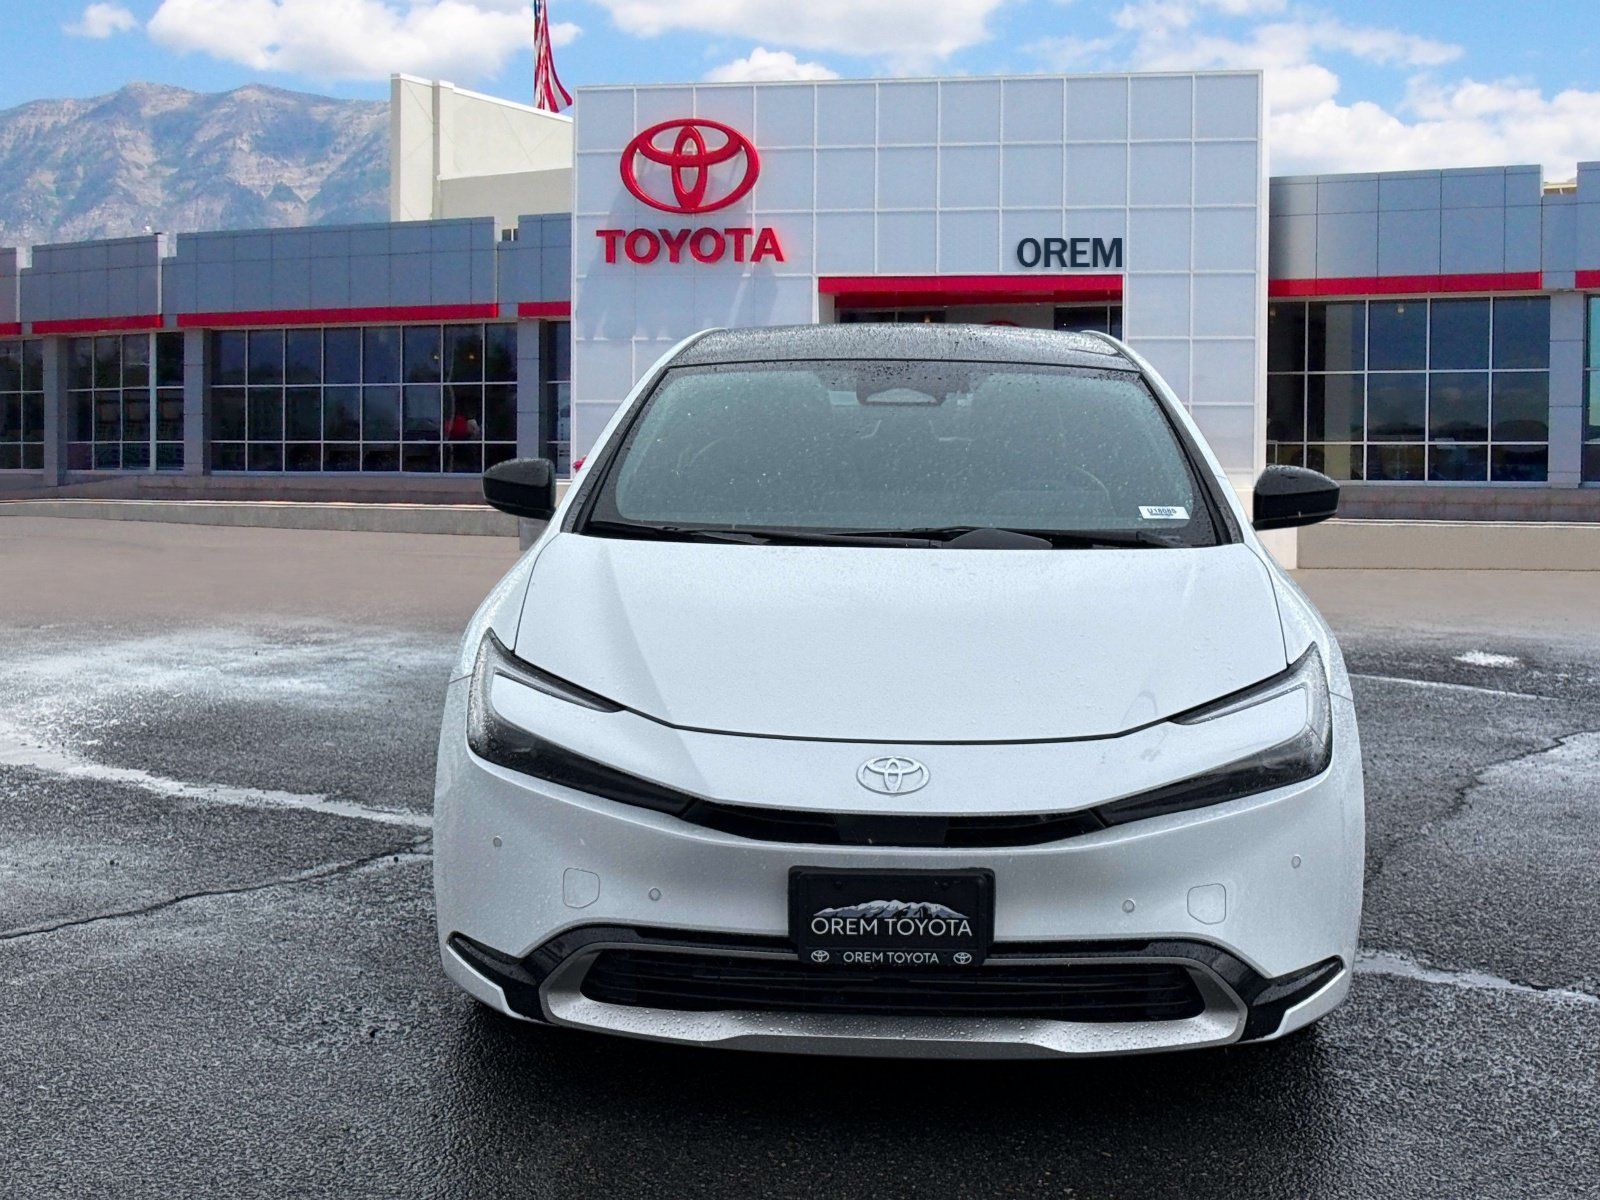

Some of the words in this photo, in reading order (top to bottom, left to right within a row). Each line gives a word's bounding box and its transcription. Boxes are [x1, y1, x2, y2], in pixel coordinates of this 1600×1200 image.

[596, 227, 784, 264] TOYOTA
[1017, 237, 1123, 268] OREM
[811, 917, 877, 935] OREM
[885, 918, 972, 936] TOYOTA
[843, 952, 883, 963] OREM
[887, 952, 939, 964] TOYOTA
